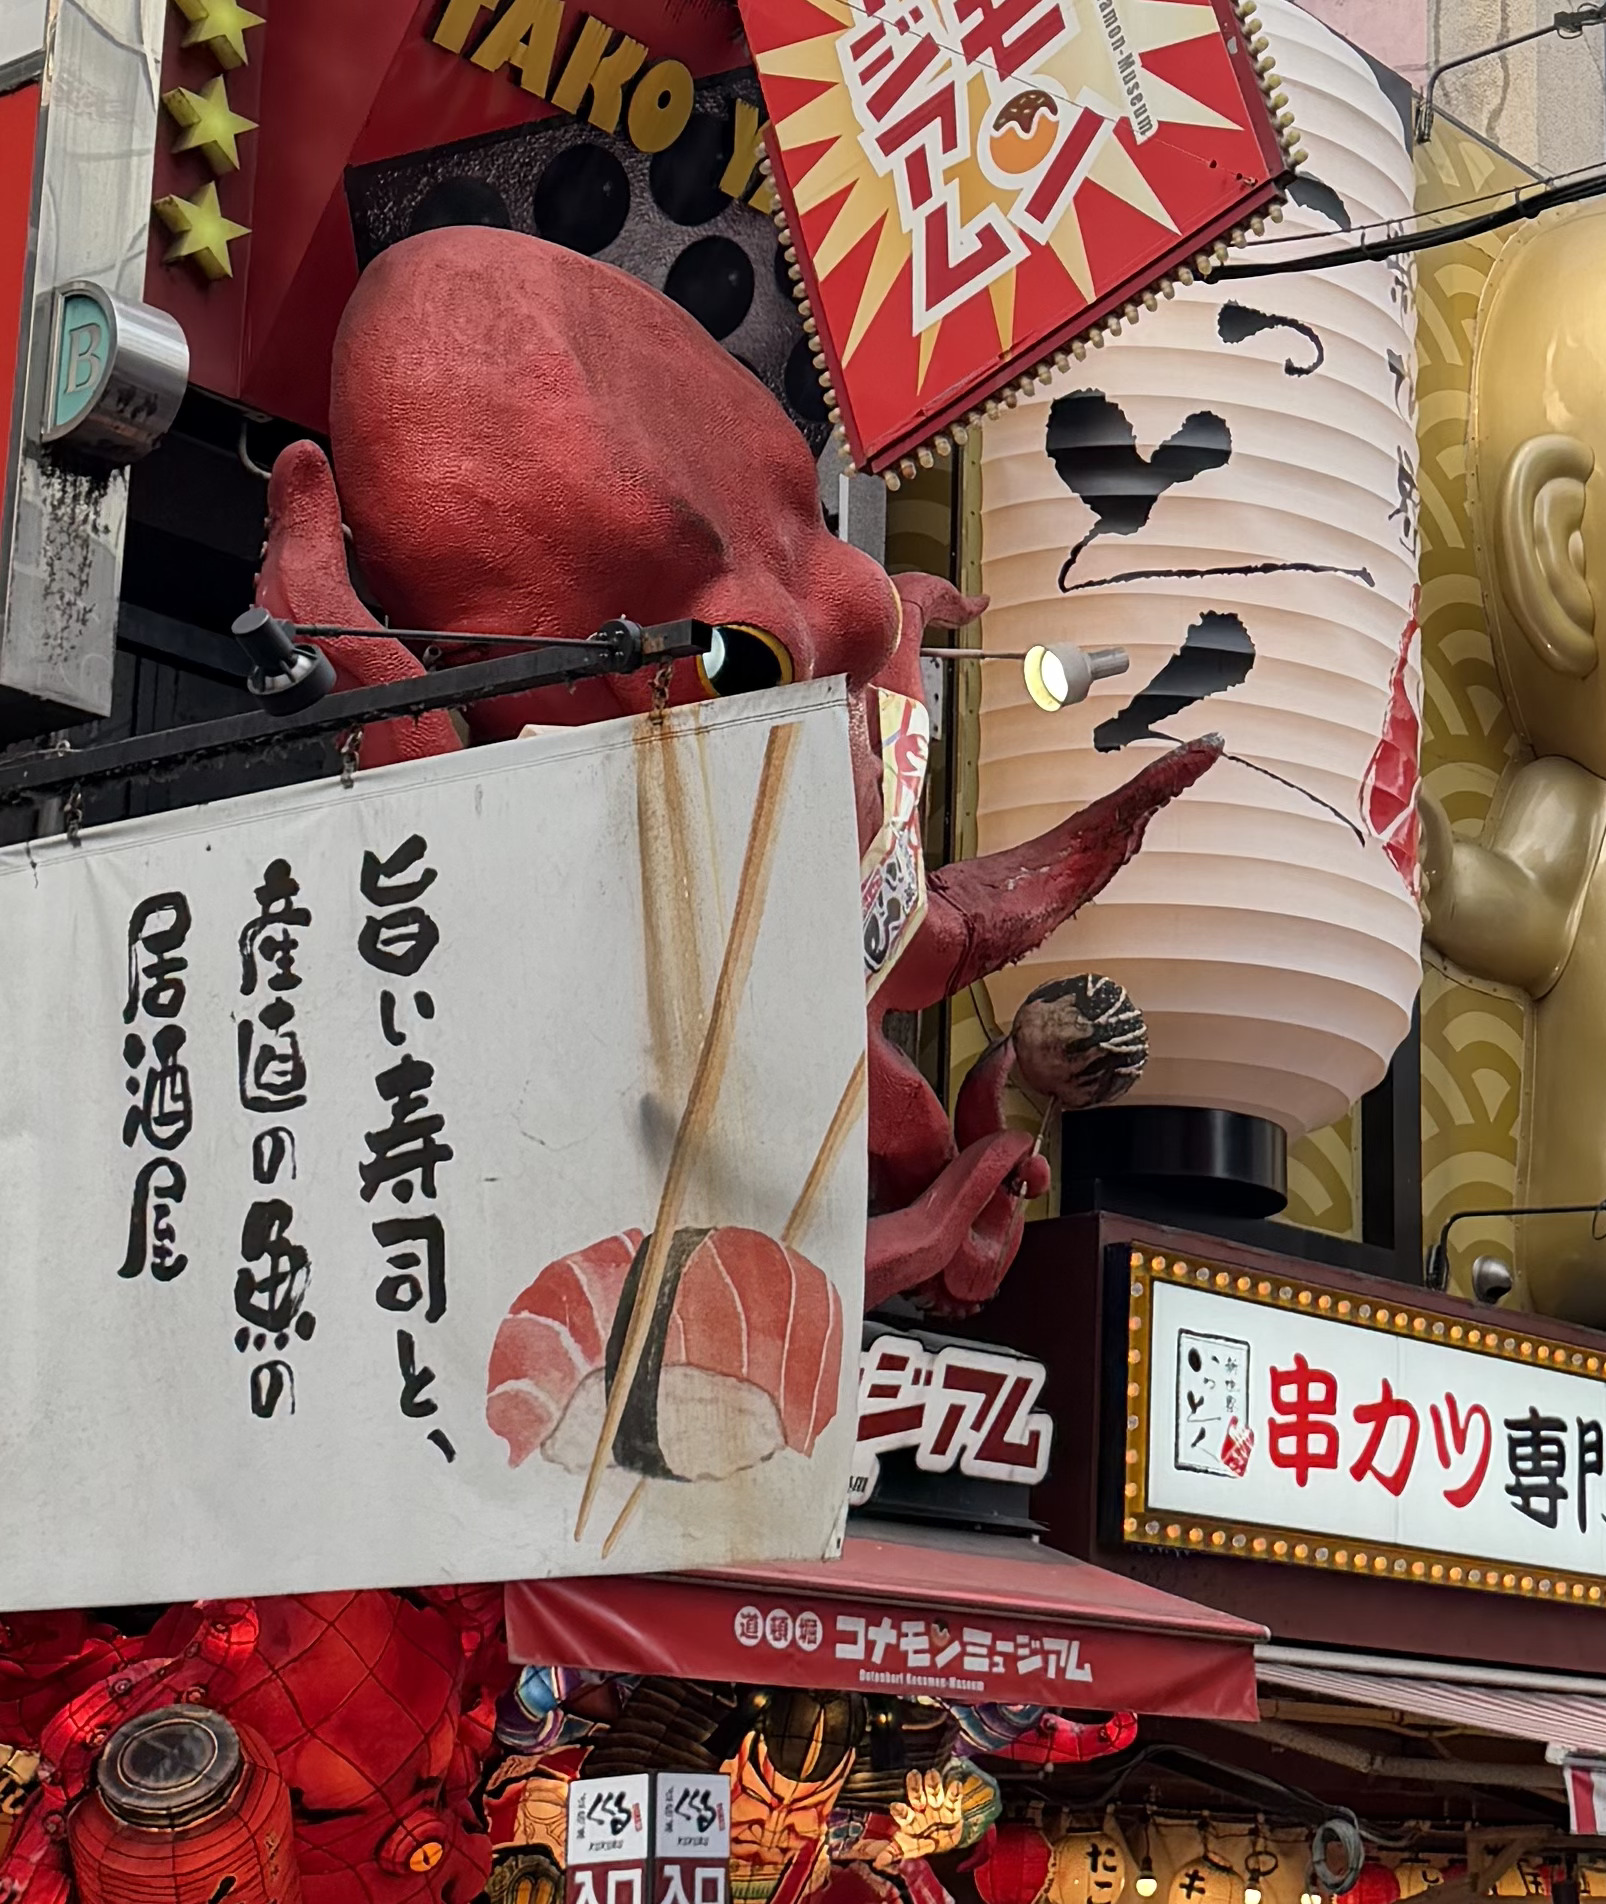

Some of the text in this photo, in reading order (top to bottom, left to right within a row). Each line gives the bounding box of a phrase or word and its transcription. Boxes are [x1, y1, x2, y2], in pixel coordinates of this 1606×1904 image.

[64, 322, 102, 394] B
[117, 891, 193, 1282] 居酒屋
[233, 858, 317, 1417] 産直の魚の
[356, 834, 454, 1462] 旨い寿司と、
[737, 1609, 1093, 1683] 道頓堀 コナモンミュージアム
